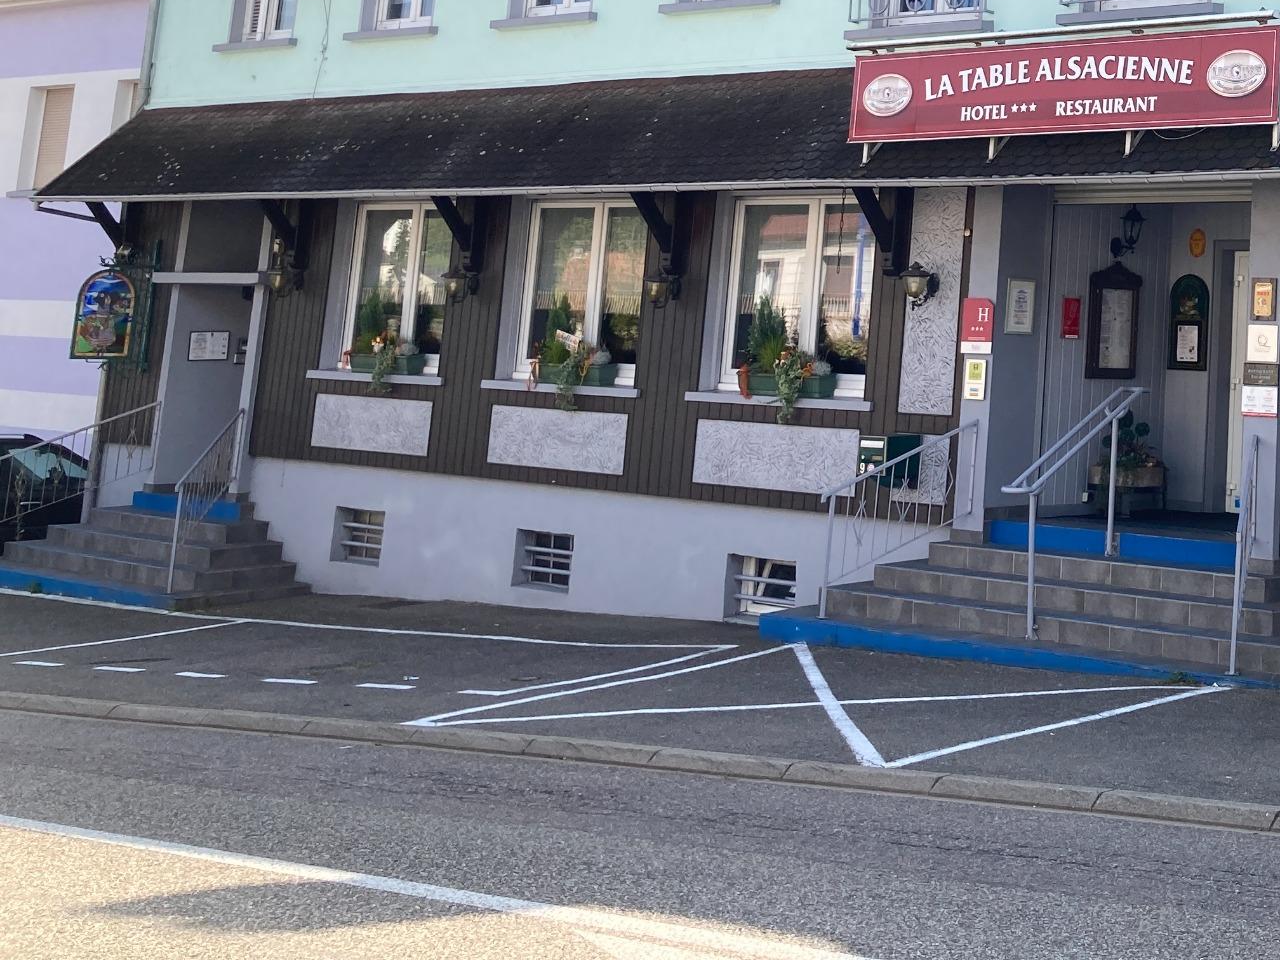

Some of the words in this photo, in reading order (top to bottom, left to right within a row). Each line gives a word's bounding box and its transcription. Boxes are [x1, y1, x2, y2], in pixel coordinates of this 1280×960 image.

[924, 74, 955, 101] LA
[959, 60, 1030, 93] TABLE
[1035, 55, 1194, 85] ALSACIENNE
[960, 104, 1008, 122] HOTEL
[1055, 96, 1158, 117] RESTAURANT
[978, 307, 990, 322] H
